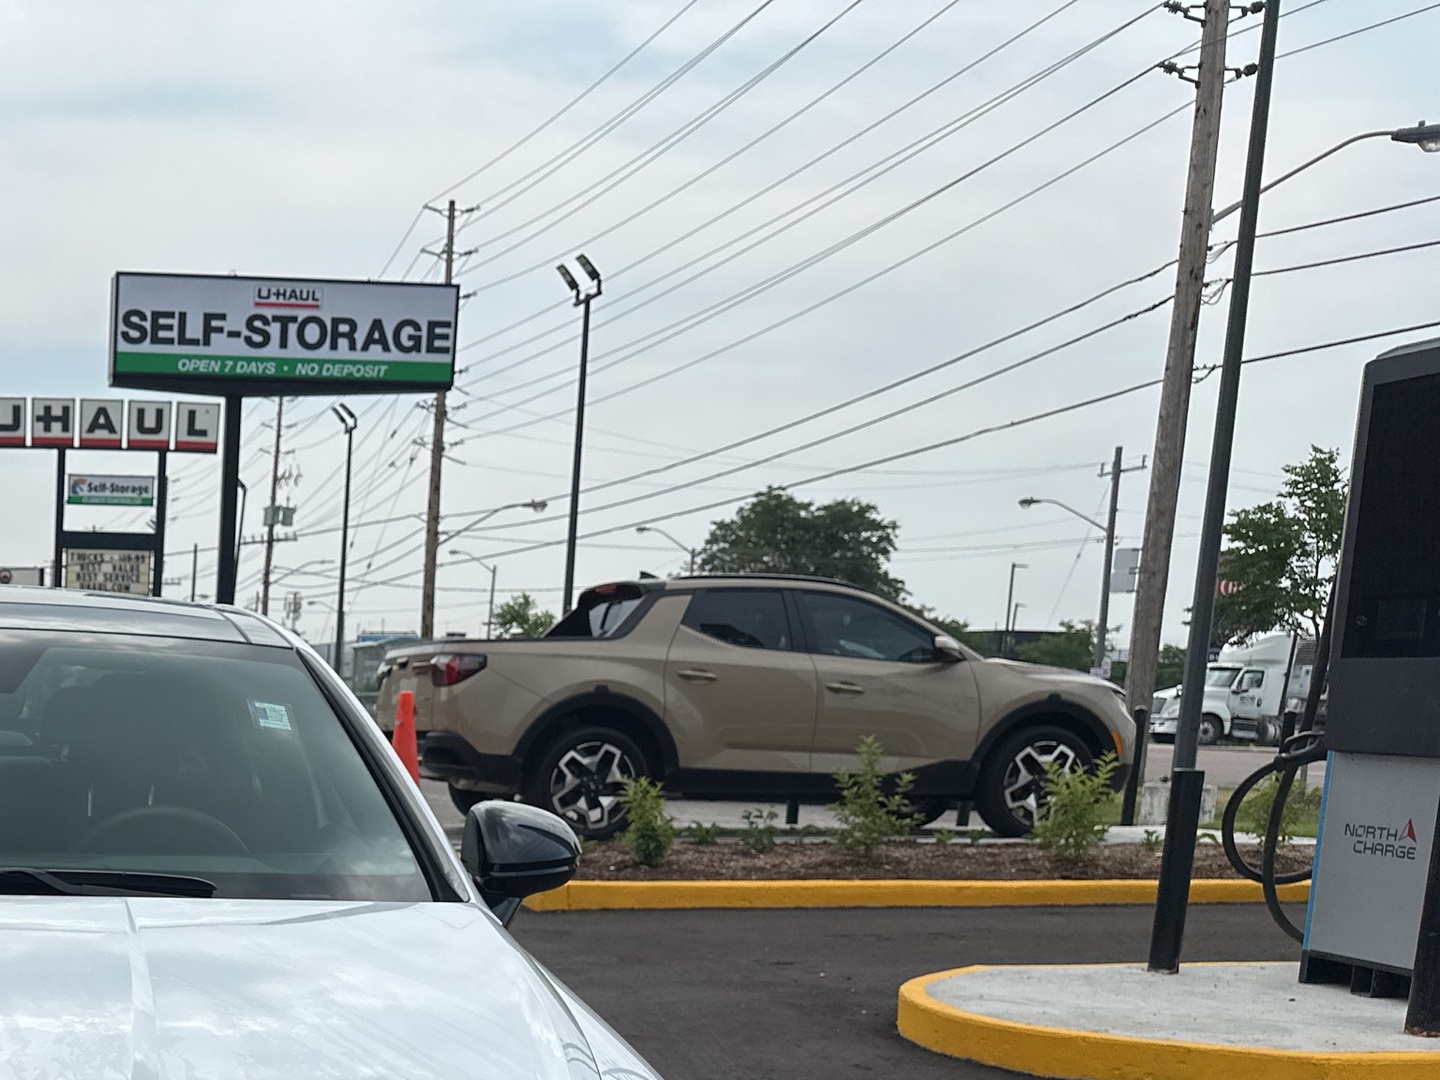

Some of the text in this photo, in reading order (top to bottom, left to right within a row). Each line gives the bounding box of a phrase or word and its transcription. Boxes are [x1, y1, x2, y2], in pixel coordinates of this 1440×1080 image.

[120, 308, 453, 355] SELF-STORAGE
[177, 358, 388, 378] OPEN 7 DAYS NO DEPOSIT
[1344, 823, 1398, 842] NORTH
[1353, 840, 1417, 861] CHARGE
